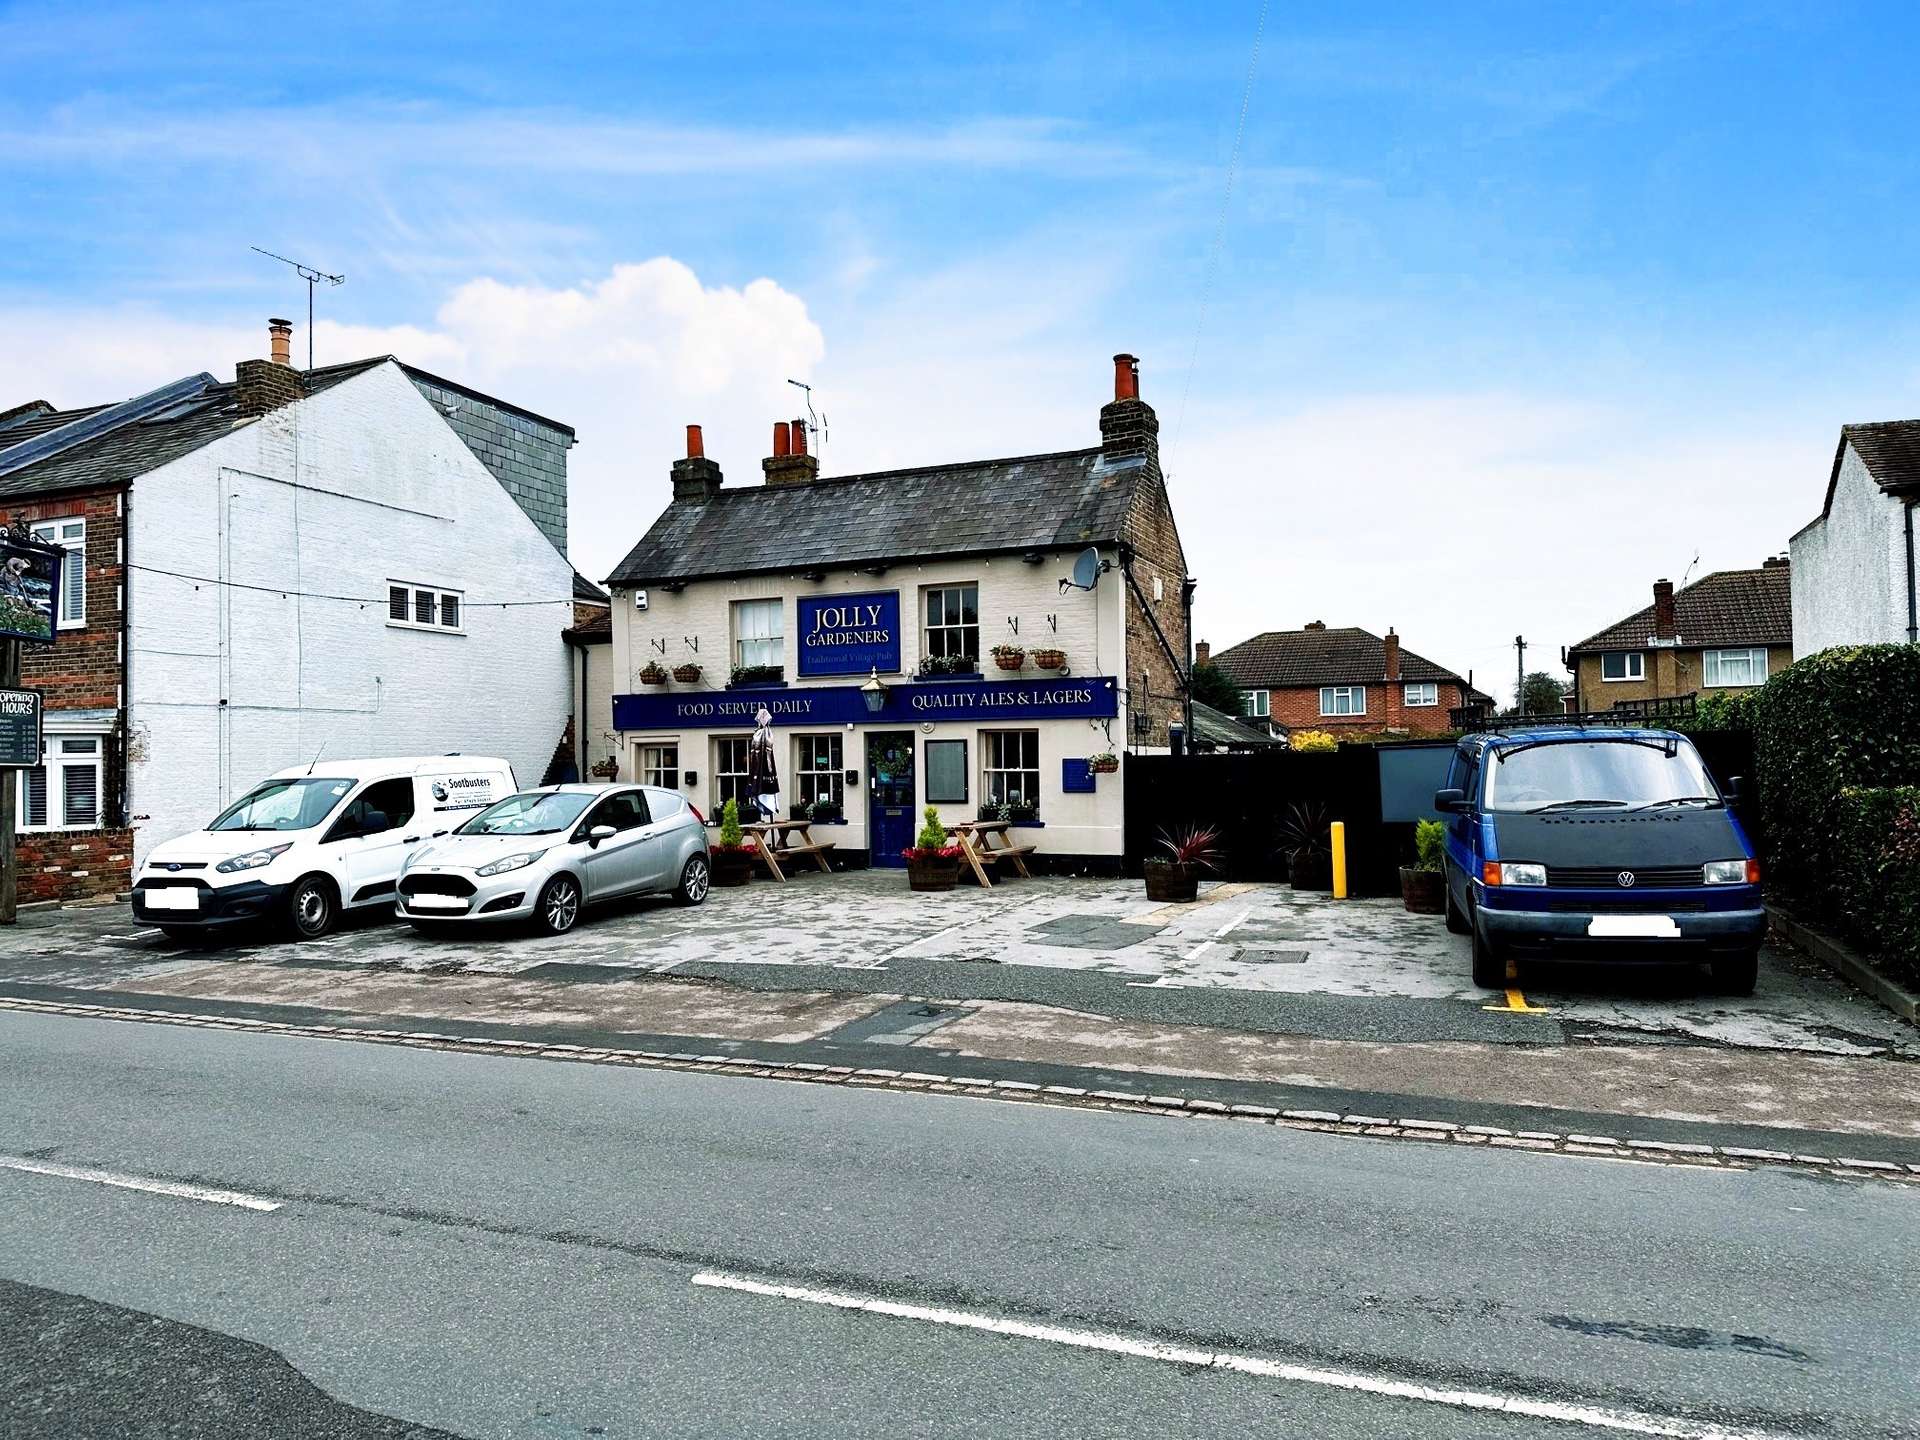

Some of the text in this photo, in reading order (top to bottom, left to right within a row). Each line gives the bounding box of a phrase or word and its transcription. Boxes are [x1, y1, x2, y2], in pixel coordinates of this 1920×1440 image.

[812, 604, 882, 634] JOLLY
[806, 629, 889, 647] GARDENERS
[677, 699, 812, 716] FOOD SERVED DAILY
[912, 688, 1092, 711] QUALITY ALES & LAGERS
[2, 702, 33, 715] HOURS
[448, 777, 491, 789] Sootbusters
